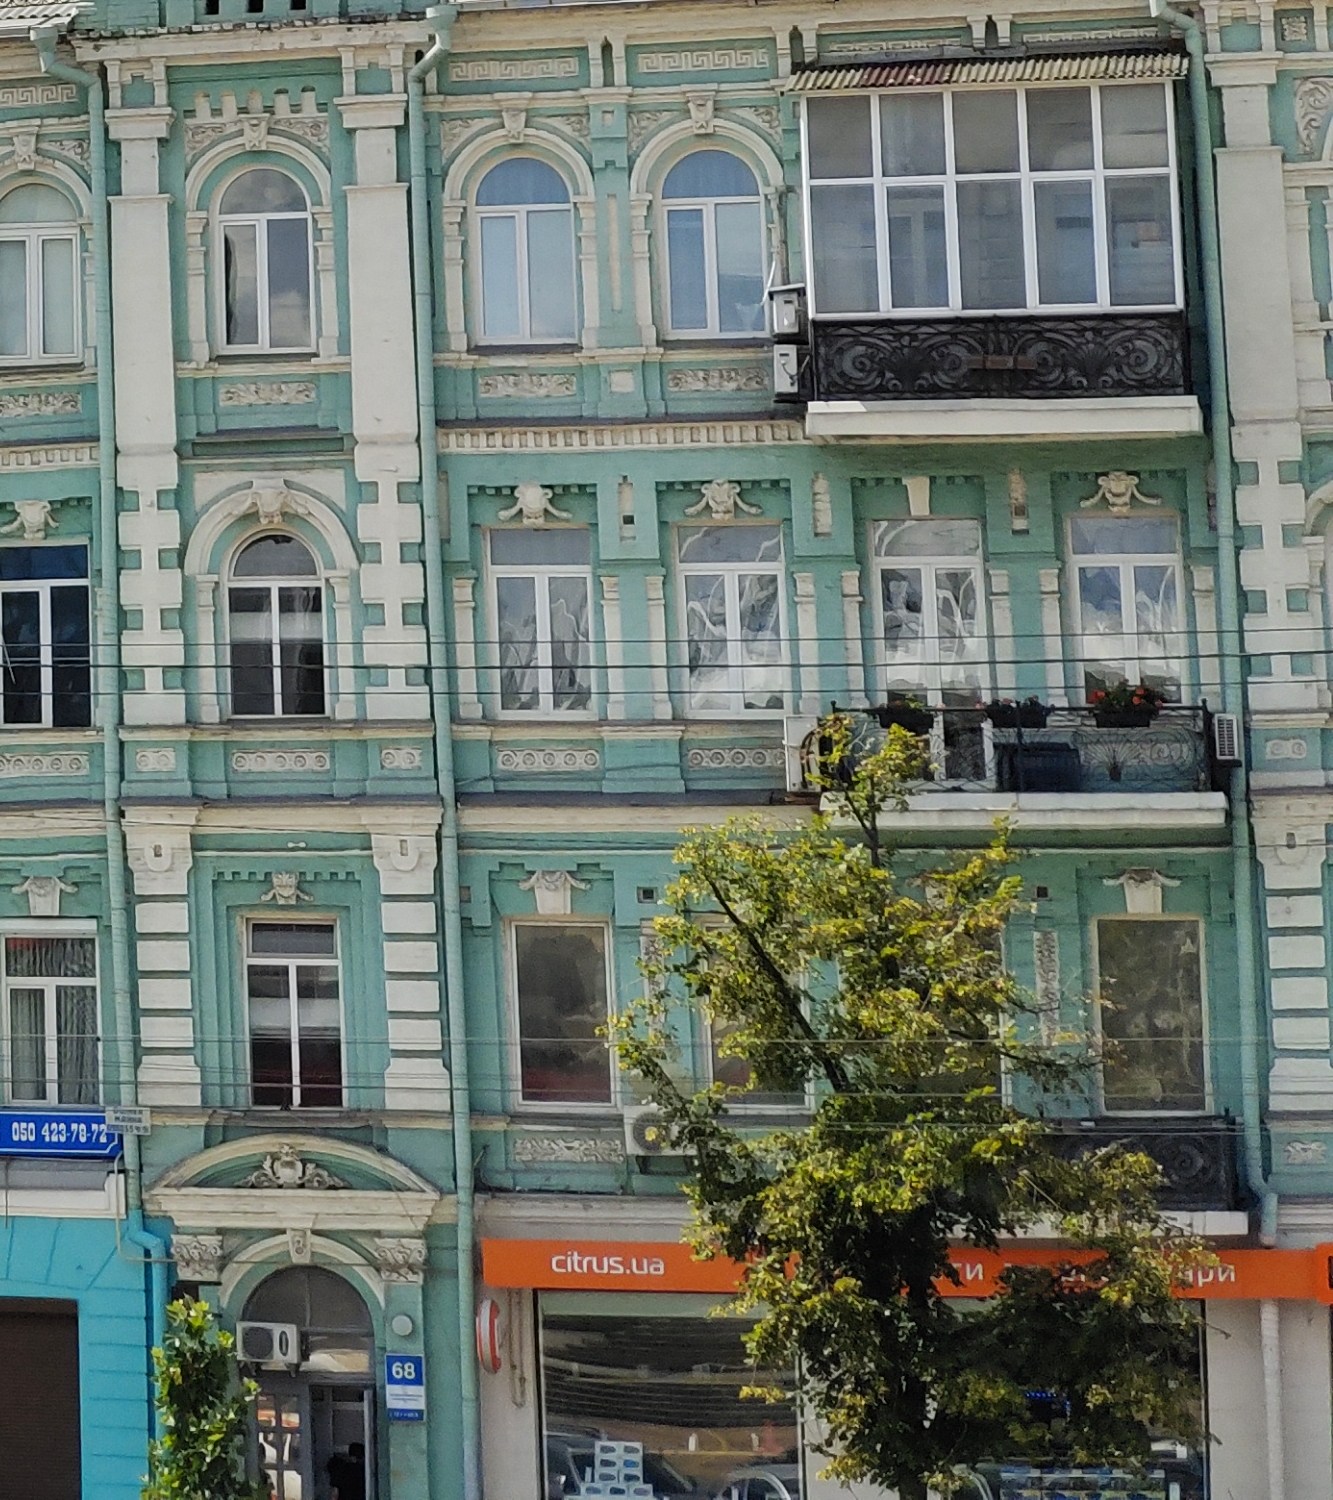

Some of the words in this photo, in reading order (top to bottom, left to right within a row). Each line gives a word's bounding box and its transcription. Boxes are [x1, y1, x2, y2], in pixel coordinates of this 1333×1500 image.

[12, 1122, 36, 1141] 050
[41, 1122, 108, 1143] 423-78-72
[550, 1250, 665, 1276] citrus.ua
[392, 1362, 416, 1380] 68
